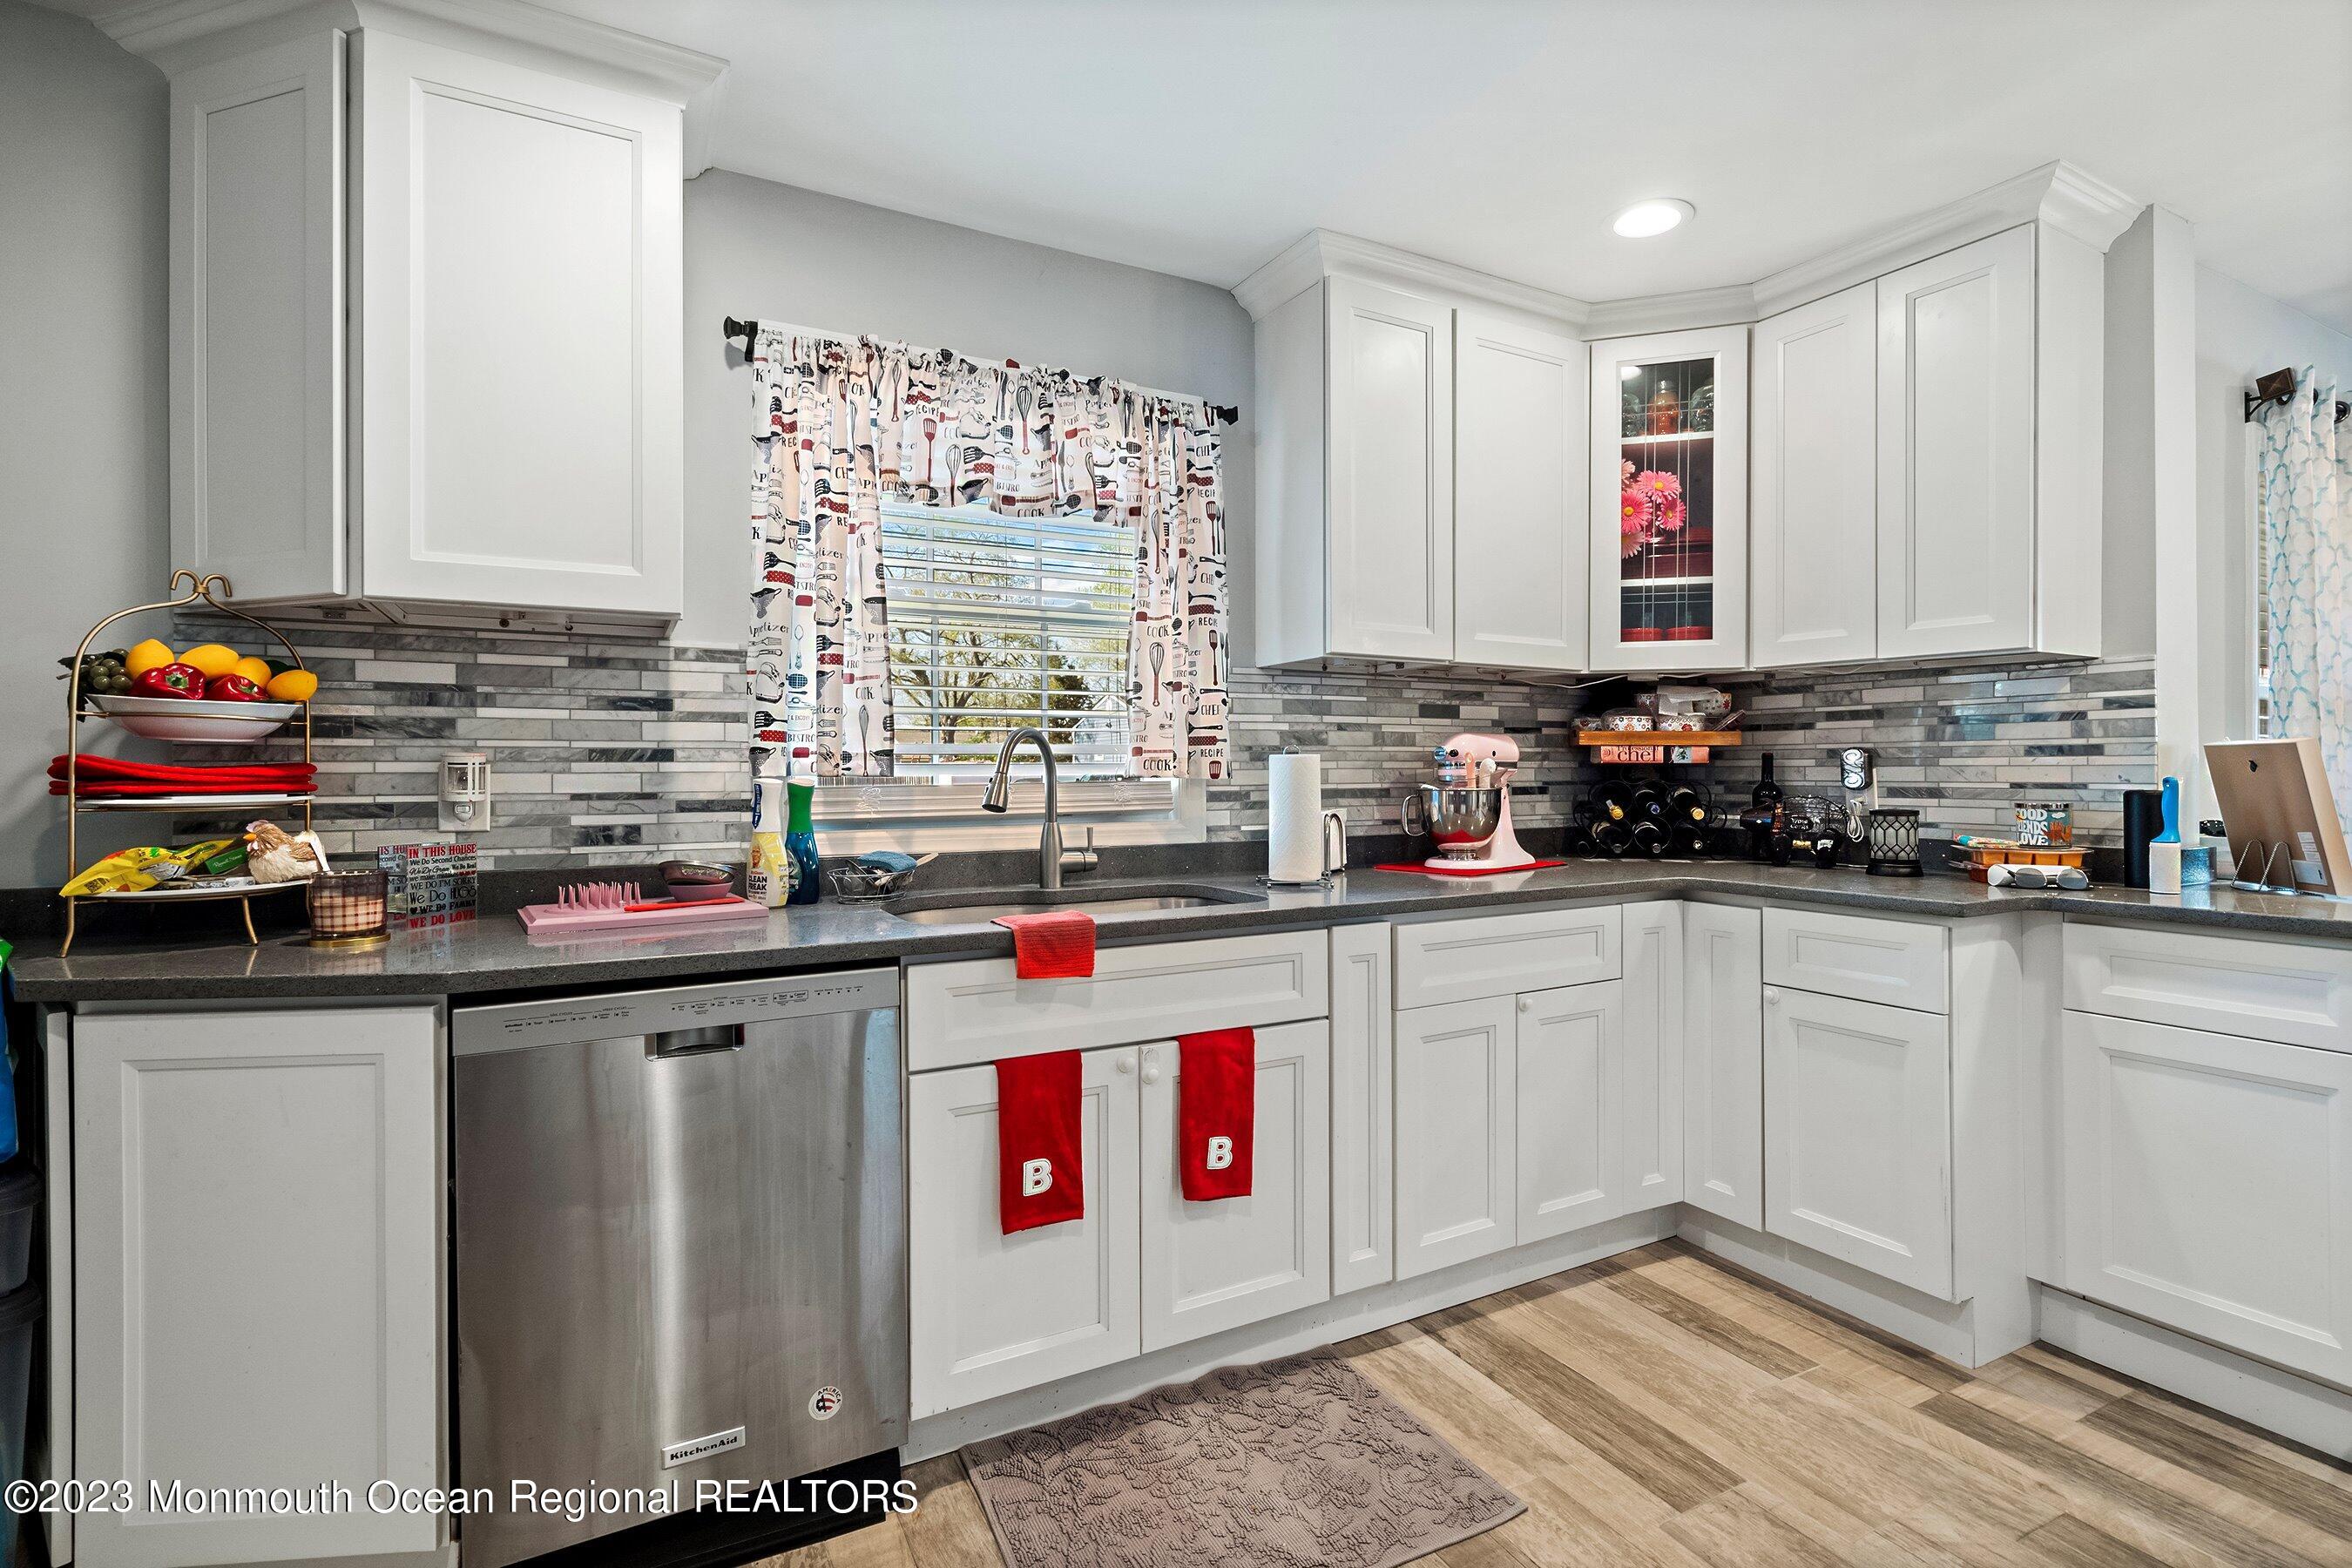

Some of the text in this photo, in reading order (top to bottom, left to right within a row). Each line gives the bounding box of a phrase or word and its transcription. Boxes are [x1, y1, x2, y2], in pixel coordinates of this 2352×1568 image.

[1201, 704, 1220, 715] CHEF
[1200, 748, 1224, 758] RECIPE
[1143, 759, 1173, 771] COOK
[2017, 833, 2049, 846] LOVE
[409, 848, 419, 859] IN
[422, 846, 446, 857] THIS
[449, 843, 476, 855] HOUSE
[431, 855, 452, 864] Second
[410, 876, 476, 890] WE DO I'M SORRY
[409, 892, 425, 904] We
[429, 889, 447, 902] Do
[419, 905, 434, 915] WE
[409, 910, 476, 929] WE DO LOVE
[1206, 1136, 1233, 1170] B
[1023, 1158, 1053, 1197] B
[817, 1387, 841, 1404] AMERICA
[670, 1436, 738, 1461] KitchenAid
